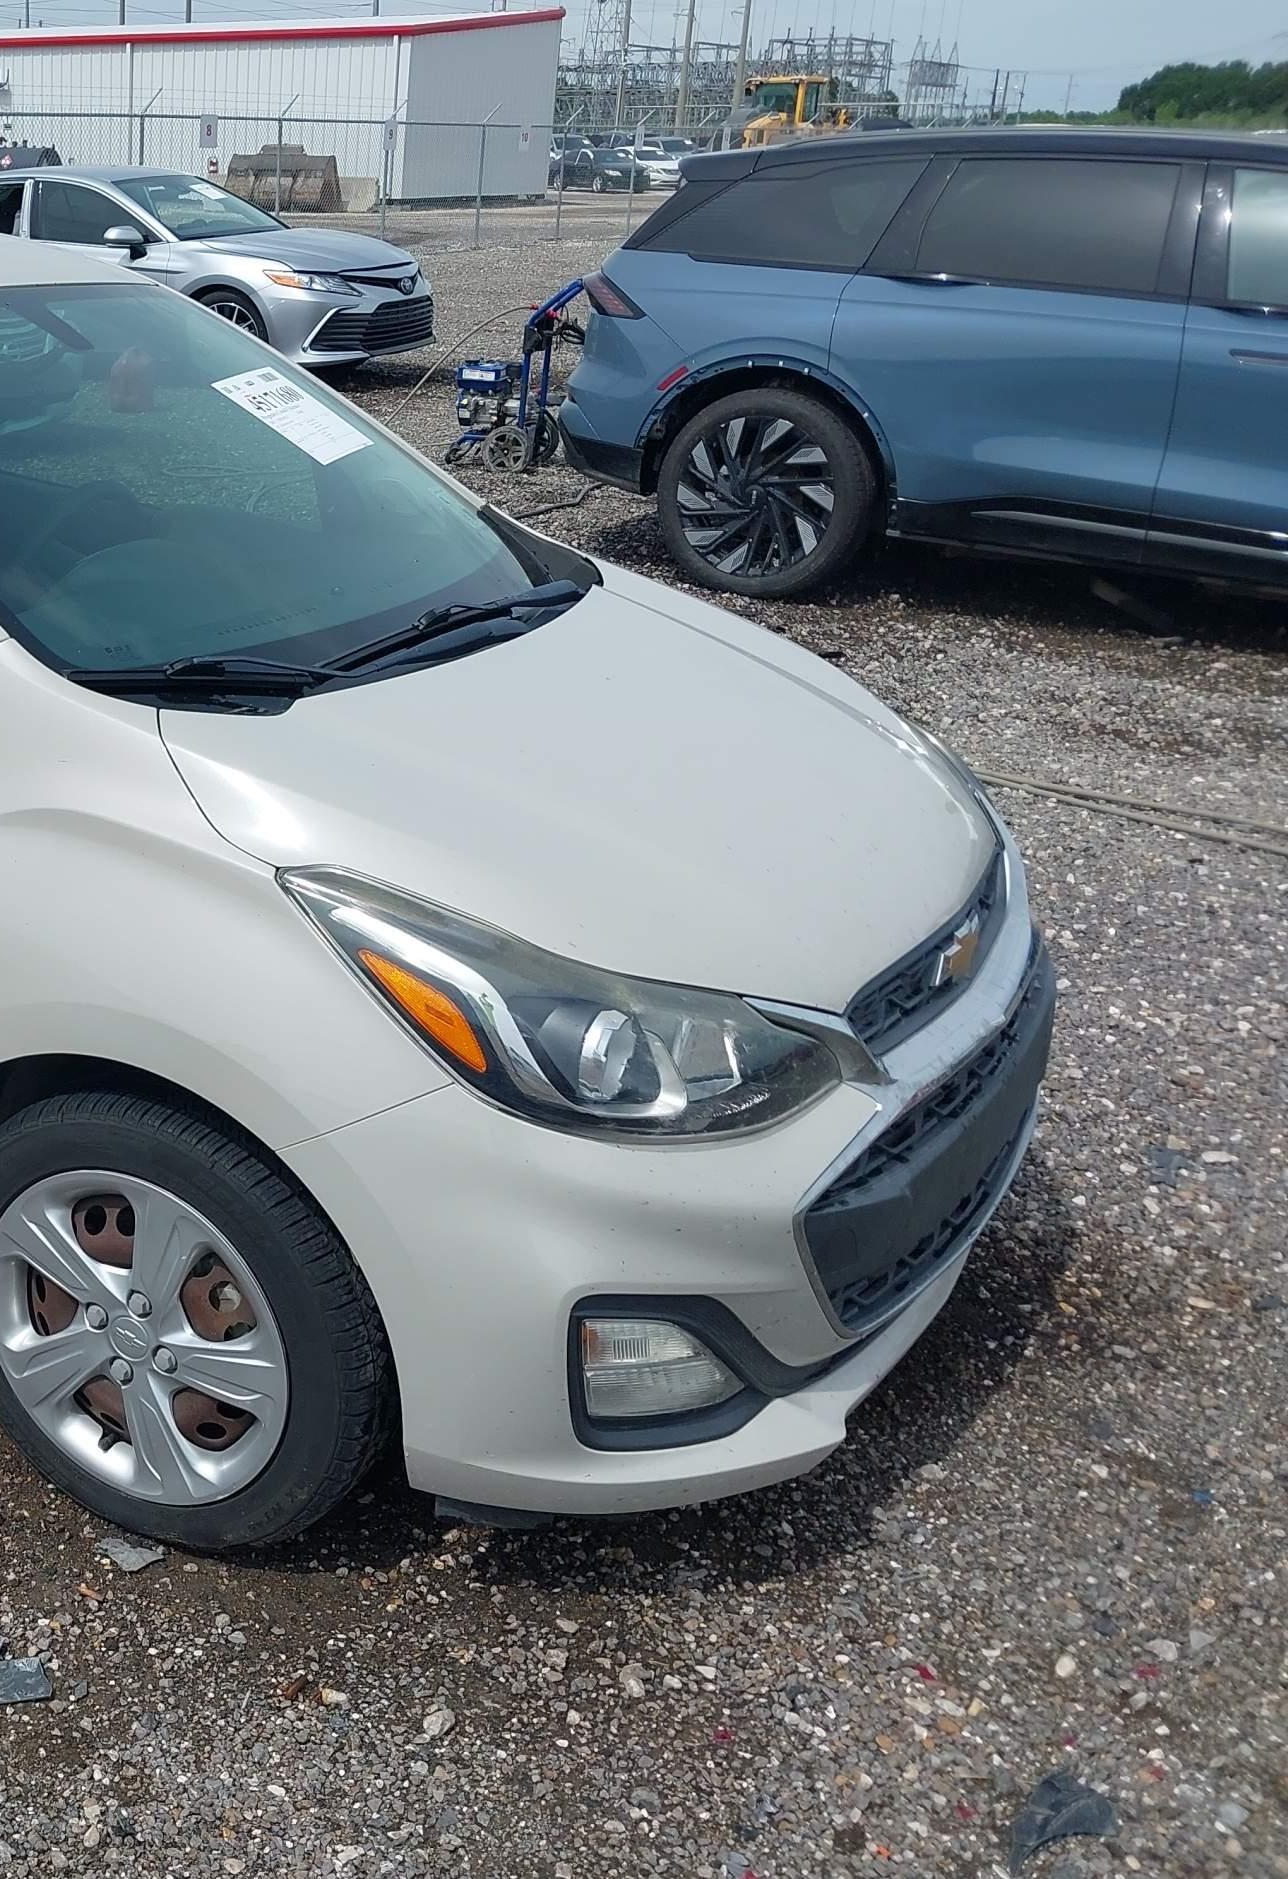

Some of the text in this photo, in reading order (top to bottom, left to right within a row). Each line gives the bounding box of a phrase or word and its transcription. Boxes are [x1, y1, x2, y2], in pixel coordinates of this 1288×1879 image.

[206, 124, 212, 137] 8
[388, 128, 394, 140] 9
[521, 132, 529, 143] 10
[247, 385, 304, 412] 45171680
